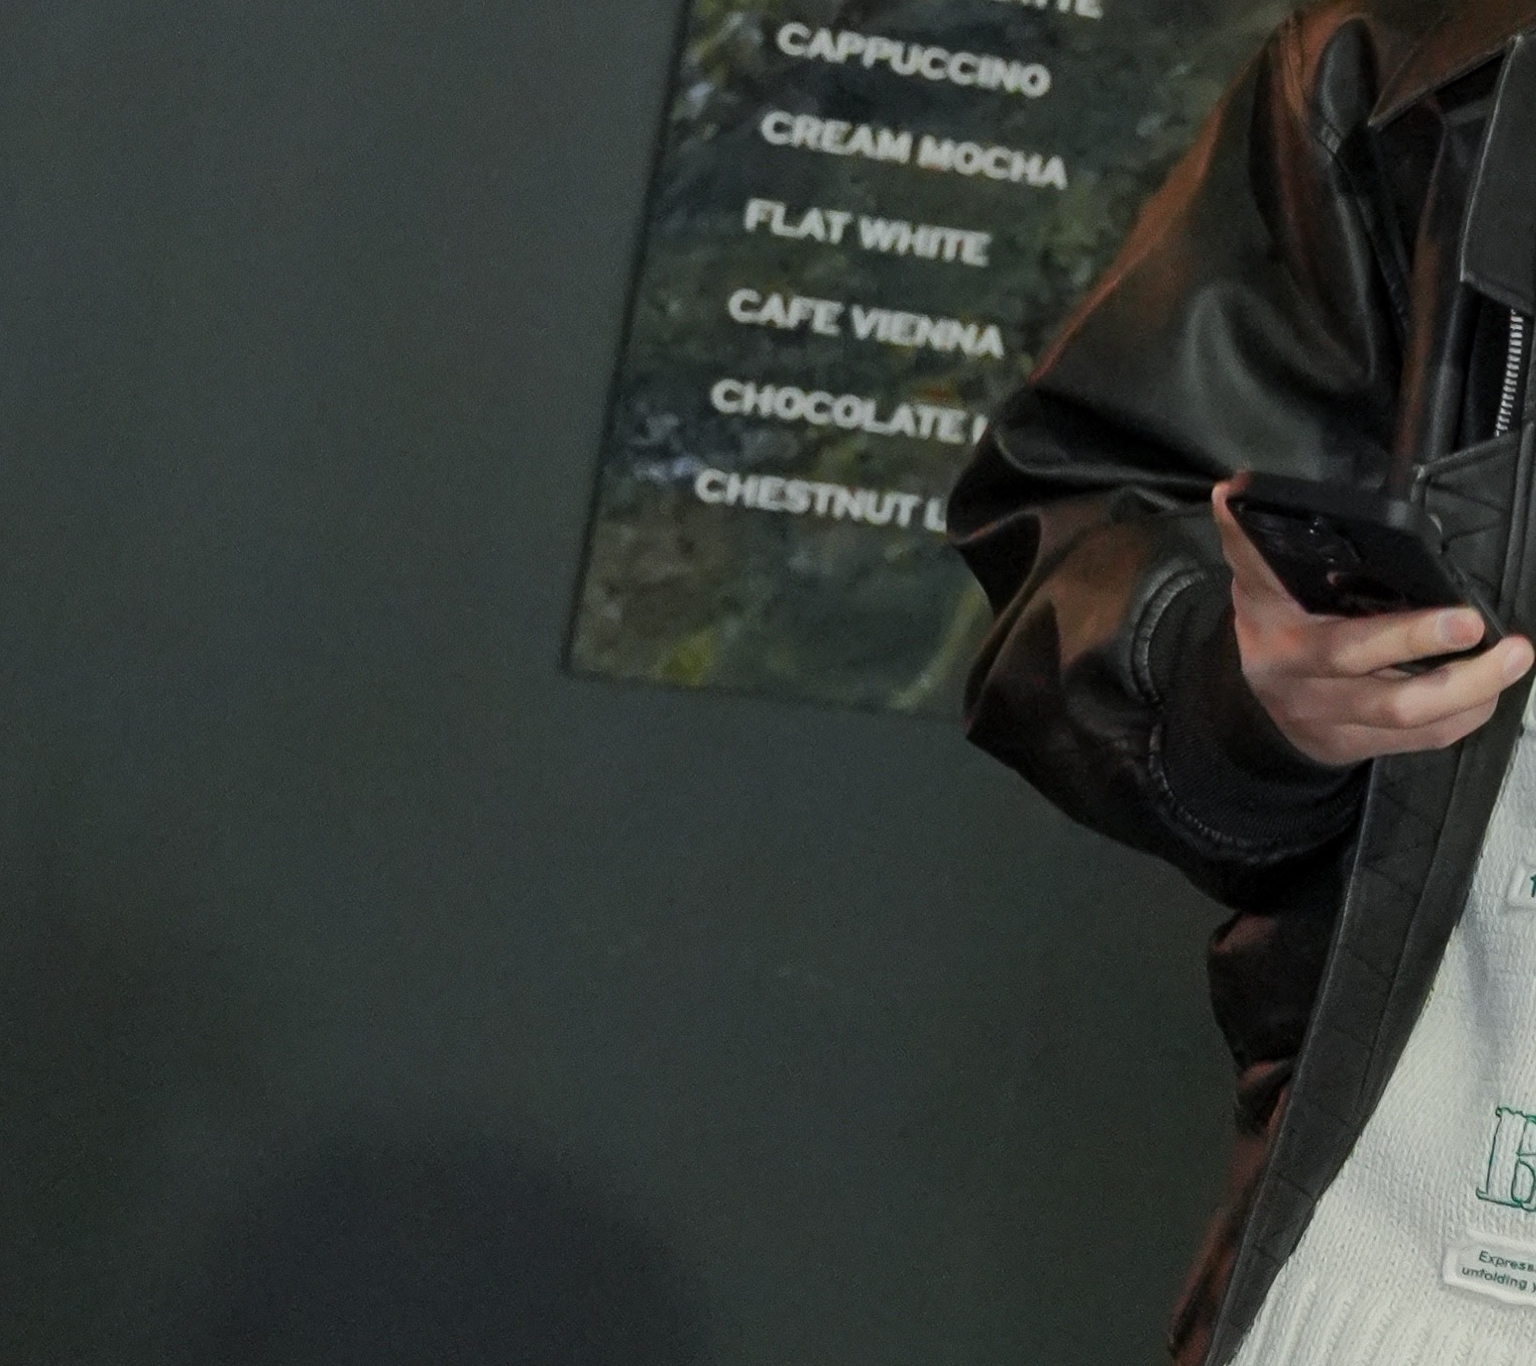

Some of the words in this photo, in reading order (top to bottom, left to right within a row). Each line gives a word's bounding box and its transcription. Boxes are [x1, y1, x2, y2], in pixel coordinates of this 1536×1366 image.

[777, 22, 1051, 98] CAPPUCCINO
[760, 110, 912, 164] CREAM
[917, 135, 1067, 190] MOCHA
[744, 197, 851, 245] FLAT
[859, 214, 993, 267] WHITE
[728, 288, 845, 336] CAFE
[852, 305, 1004, 359] VIENNA
[710, 379, 969, 445] CHOCOLATE
[694, 468, 923, 527] CHESTNUT
[1461, 1266, 1528, 1291] unfolding
